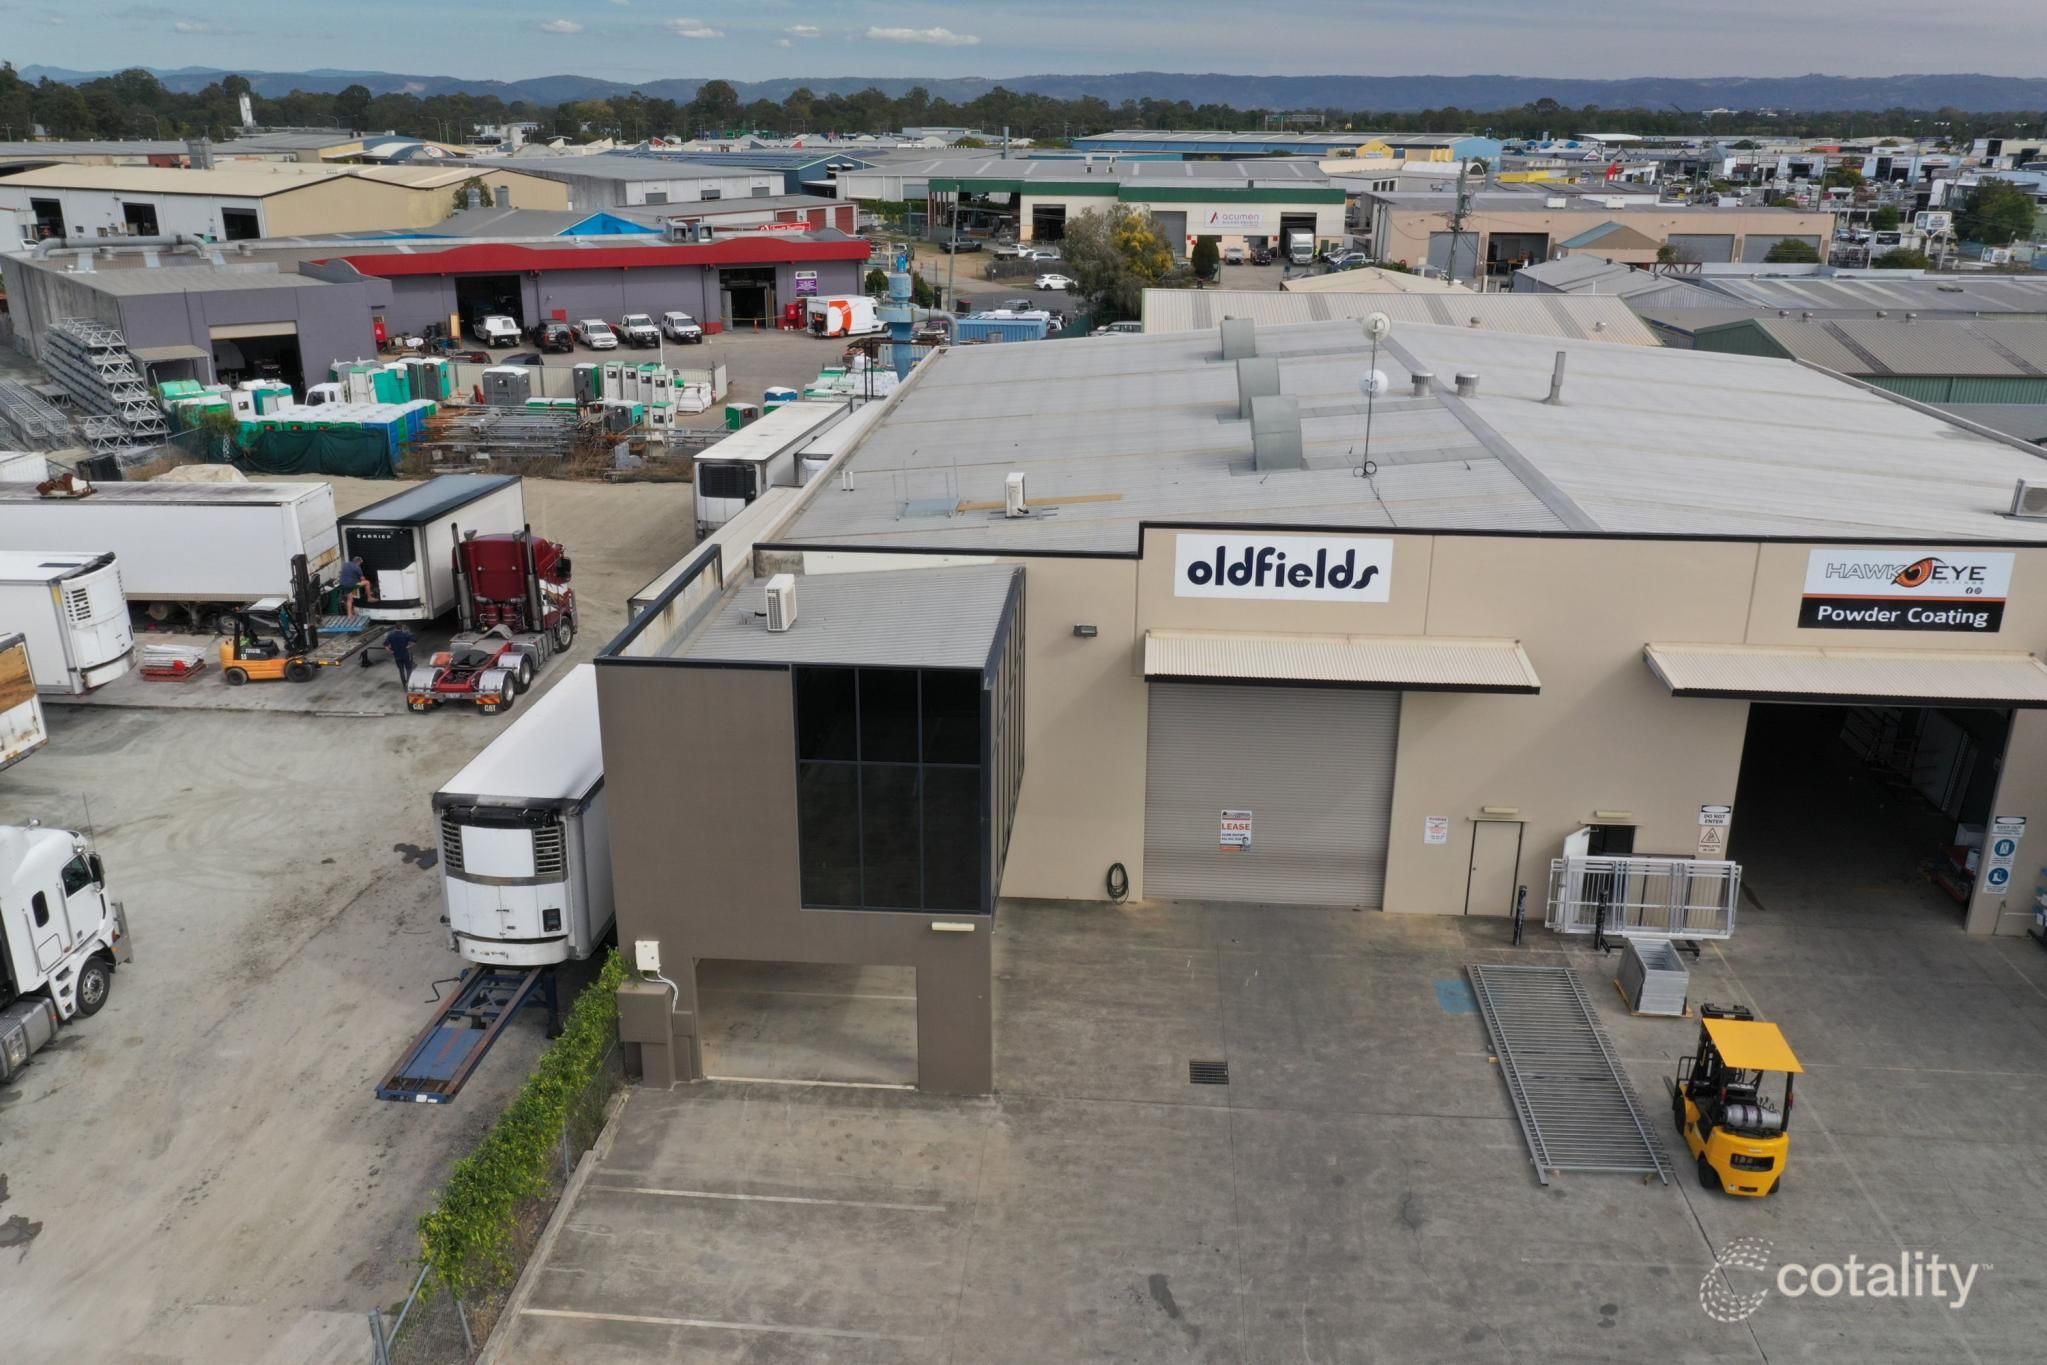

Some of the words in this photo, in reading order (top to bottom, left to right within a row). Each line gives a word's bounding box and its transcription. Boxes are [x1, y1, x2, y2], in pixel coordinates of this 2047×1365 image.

[1187, 545, 1379, 590] oldfields
[1825, 562, 1908, 580] HAWK
[1931, 565, 1988, 581] EYE
[1817, 605, 1901, 623] Powder
[1907, 607, 1989, 628] Coating
[412, 703, 425, 711] CAT
[484, 704, 497, 712] CAT
[1221, 823, 1251, 831] LEASE
